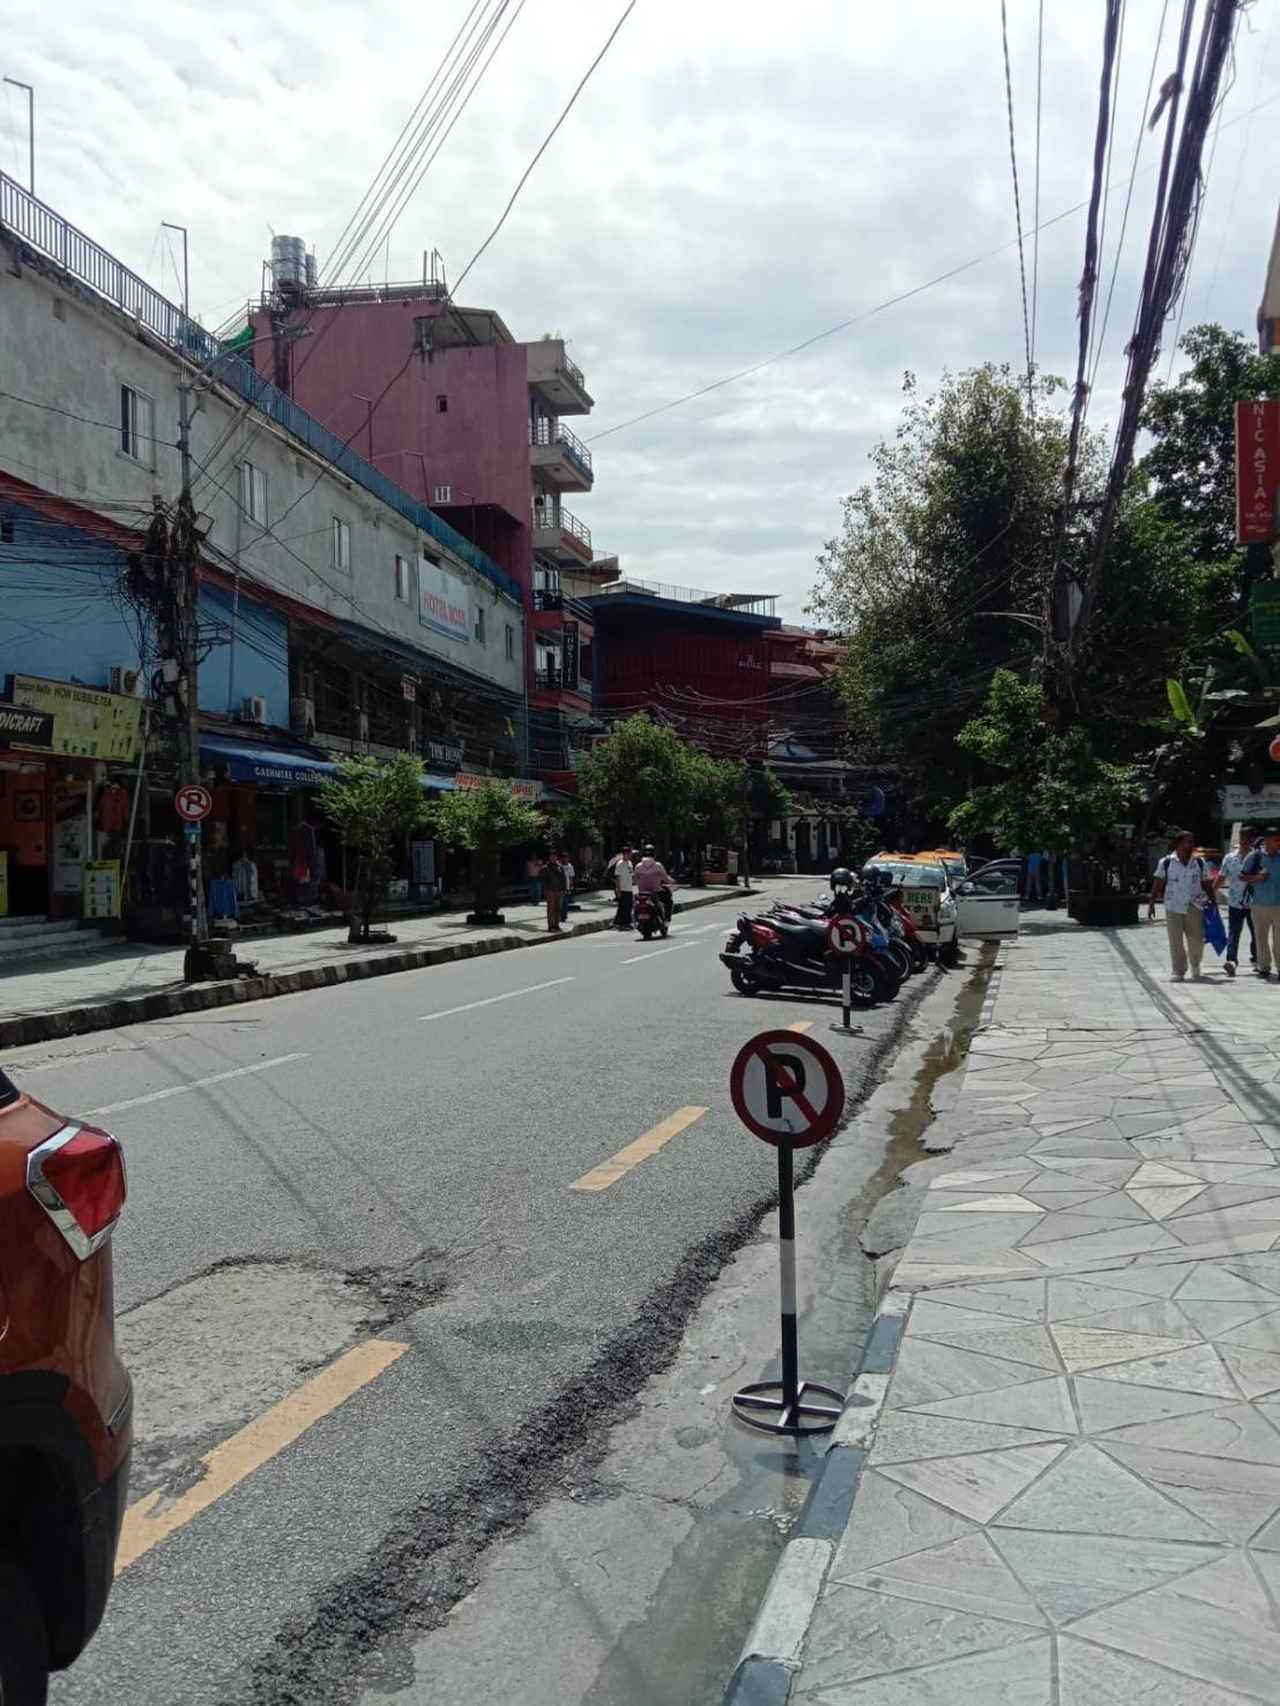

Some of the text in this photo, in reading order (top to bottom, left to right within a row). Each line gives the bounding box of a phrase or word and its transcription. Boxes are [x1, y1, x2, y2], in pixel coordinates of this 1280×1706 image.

[1253, 402, 1265, 443] NIC
[1253, 447, 1267, 498] ASIA
[72, 689, 99, 706] BUBBLE
[99, 696, 112, 707] TEA
